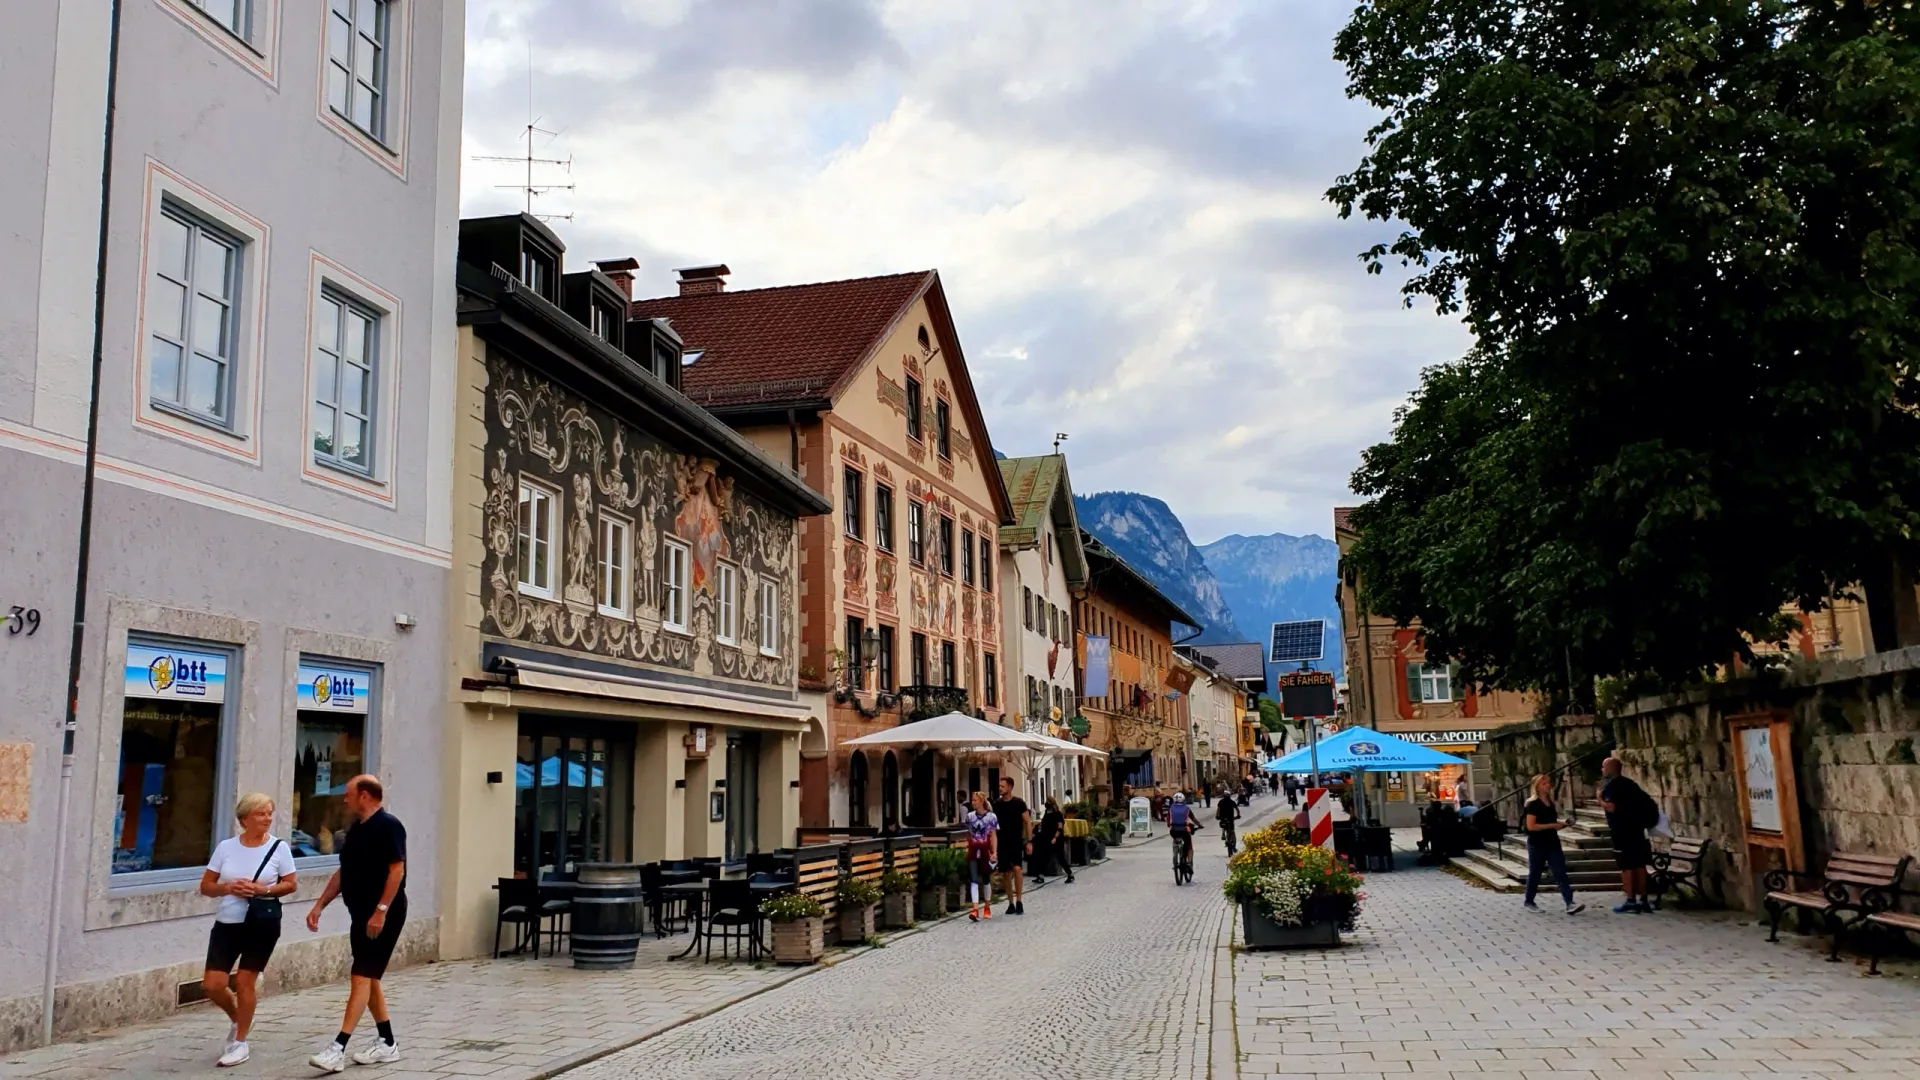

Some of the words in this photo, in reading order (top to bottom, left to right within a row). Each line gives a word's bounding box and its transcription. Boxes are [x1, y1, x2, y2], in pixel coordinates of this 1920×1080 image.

[9, 605, 41, 636] 39
[176, 658, 207, 682] btt
[1281, 676, 1296, 687] SIE
[1297, 674, 1332, 686] FAHREN
[333, 676, 354, 696] btt
